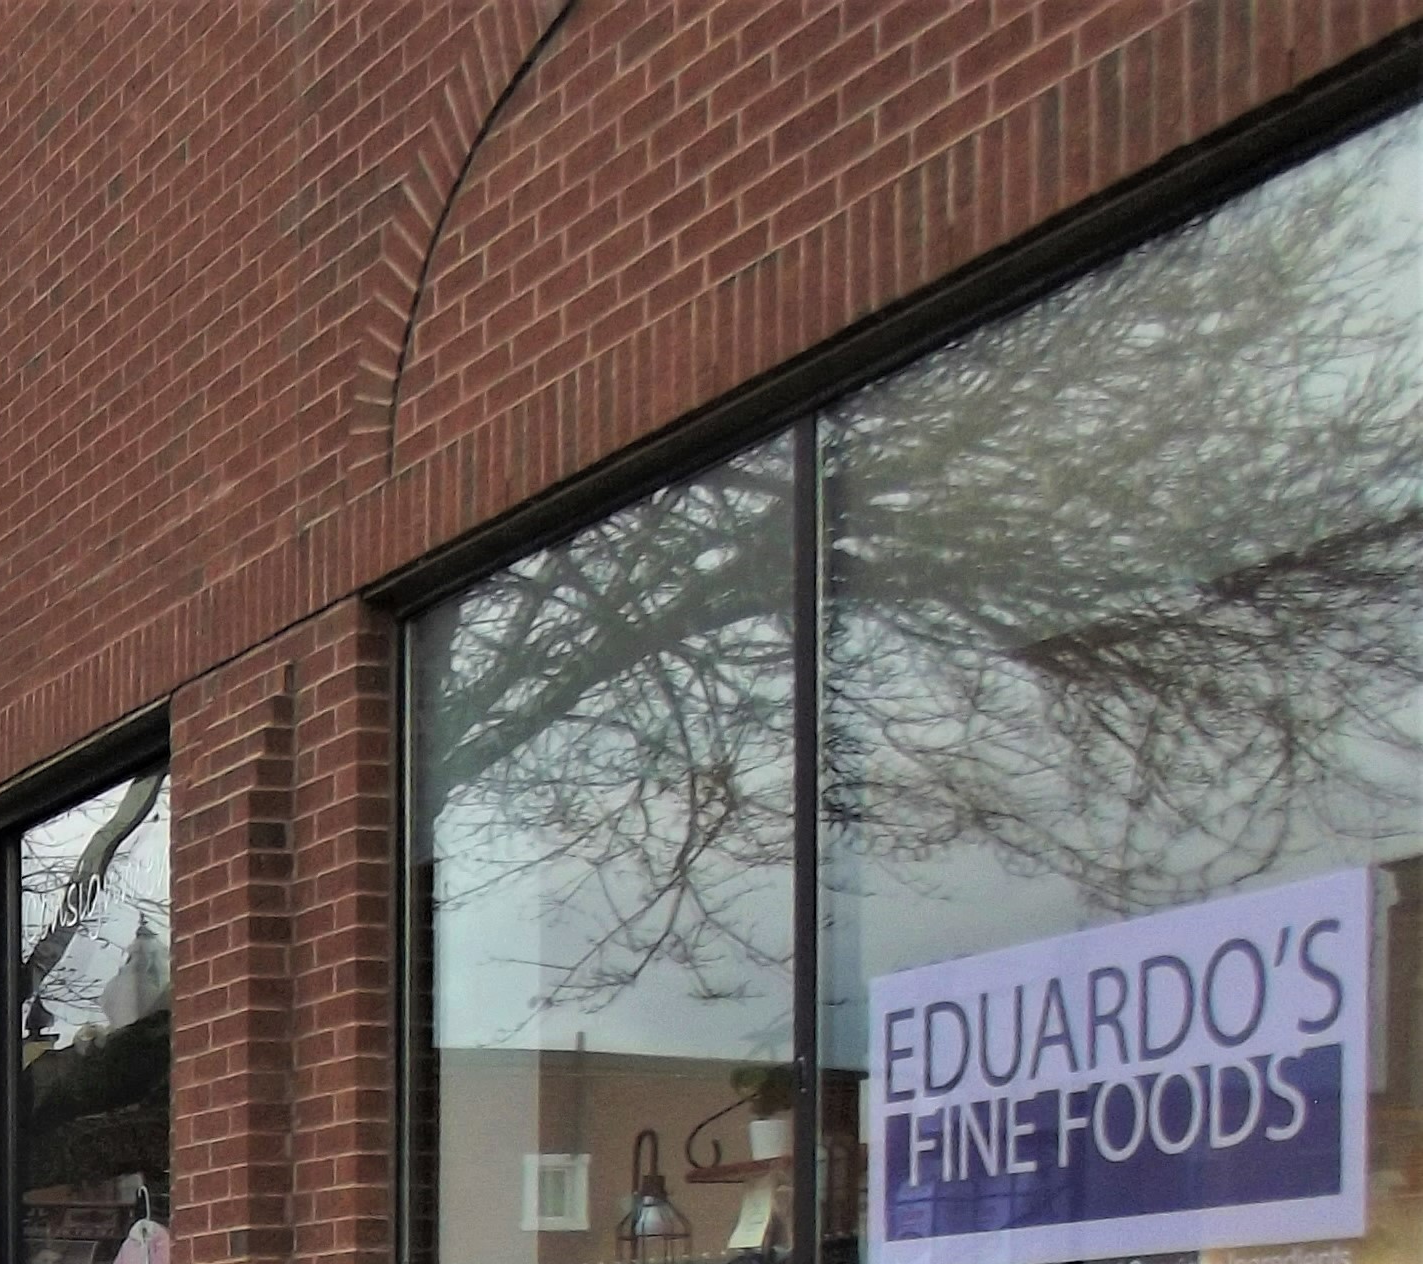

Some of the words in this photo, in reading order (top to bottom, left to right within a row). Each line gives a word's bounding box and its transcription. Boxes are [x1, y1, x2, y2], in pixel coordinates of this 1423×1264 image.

[884, 918, 1343, 1104] EDUARDO'S
[908, 1096, 1038, 1188] FINE
[1057, 1050, 1307, 1169] FOODS
